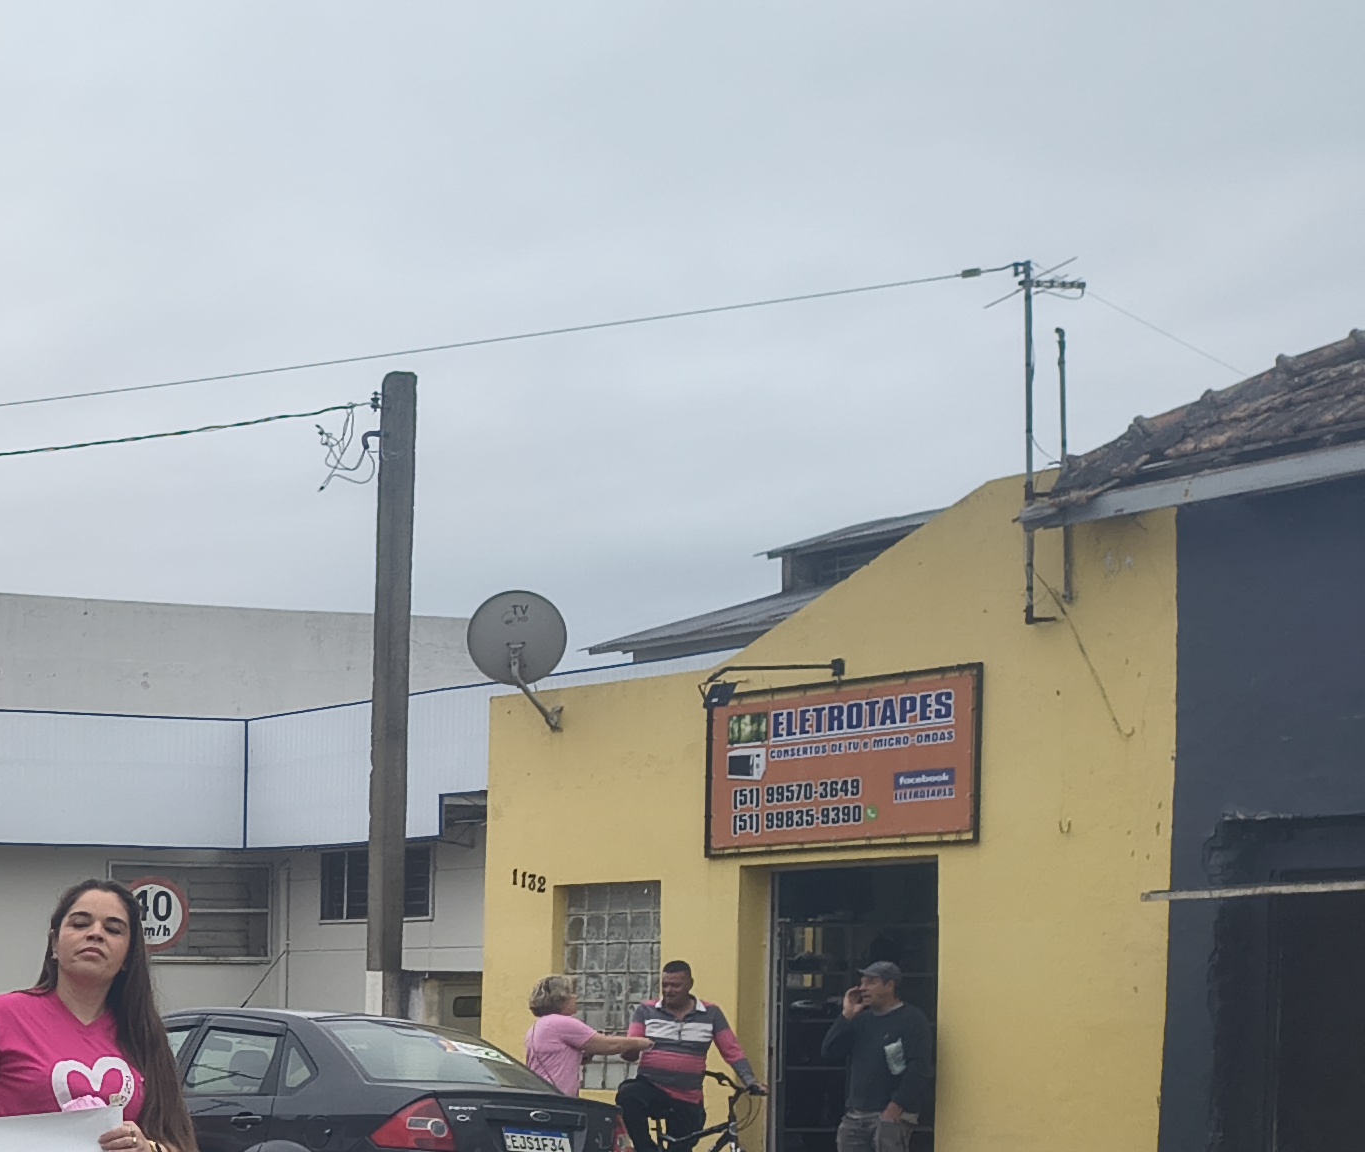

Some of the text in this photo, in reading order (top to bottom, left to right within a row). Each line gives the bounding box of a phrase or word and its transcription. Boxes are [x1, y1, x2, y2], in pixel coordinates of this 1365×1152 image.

[511, 604, 529, 615] TV
[771, 690, 955, 739] ELETROTAPES
[769, 730, 955, 760] CONSERTOS DE TV e MICRO-ONDAS
[899, 771, 950, 786] facebook
[732, 777, 862, 811] (51) 99570-3649
[732, 804, 863, 836] (51) 99835-9390
[136, 889, 173, 922] 40
[143, 924, 171, 937] m/h
[510, 1135, 566, 1152] EJS1F34
